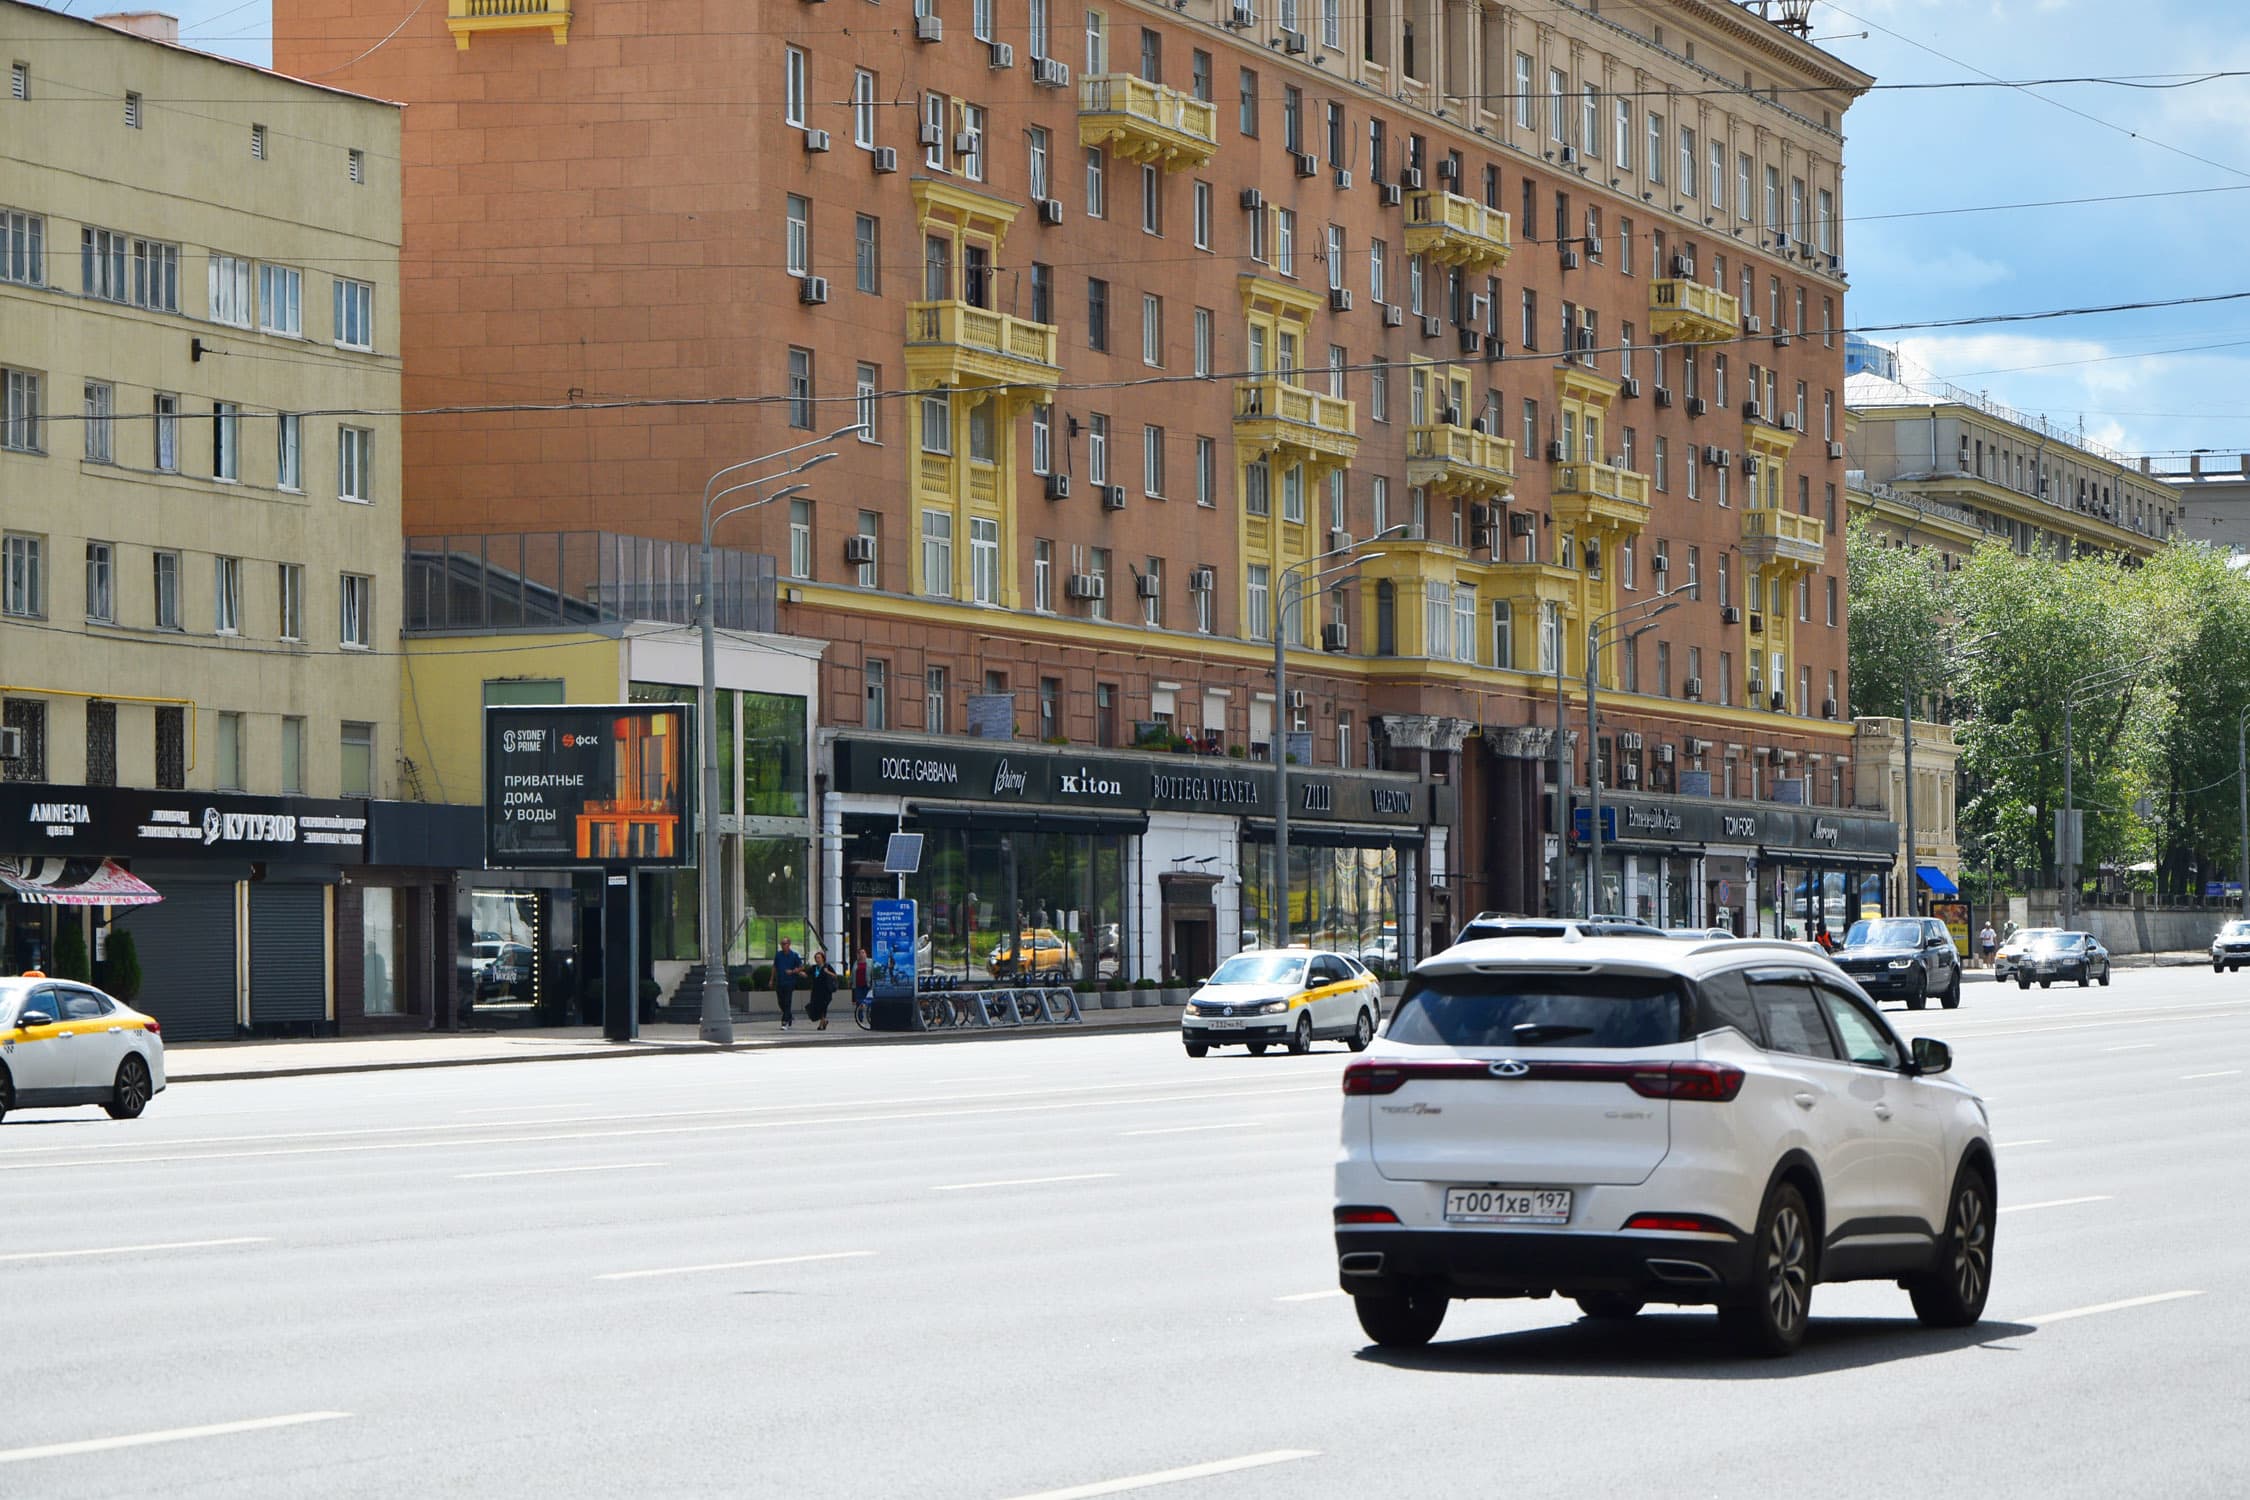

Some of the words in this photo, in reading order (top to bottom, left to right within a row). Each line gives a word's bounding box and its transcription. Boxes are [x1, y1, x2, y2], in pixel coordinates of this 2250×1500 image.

[517, 729, 546, 740] SYDNEY
[575, 735, 598, 746] ФСК
[517, 741, 541, 752] PRIME
[504, 774, 584, 787] ПРИВАТНЫЕ
[993, 758, 1027, 796] Brioni
[1060, 766, 1121, 795] Kiton
[1154, 774, 1208, 801] BOTTEGA
[1212, 778, 1258, 804] VENETA
[1305, 784, 1331, 811] ZILLI
[503, 792, 543, 806] ДОМА
[29, 803, 91, 823] AMNESIA
[504, 809, 513, 821] У
[517, 809, 556, 822] ВОДЫ
[222, 813, 297, 842] КУТУЗОВ
[1724, 816, 1739, 836] TOM
[1739, 817, 1756, 837] FORD
[1535, 1192, 1566, 1209] 197
